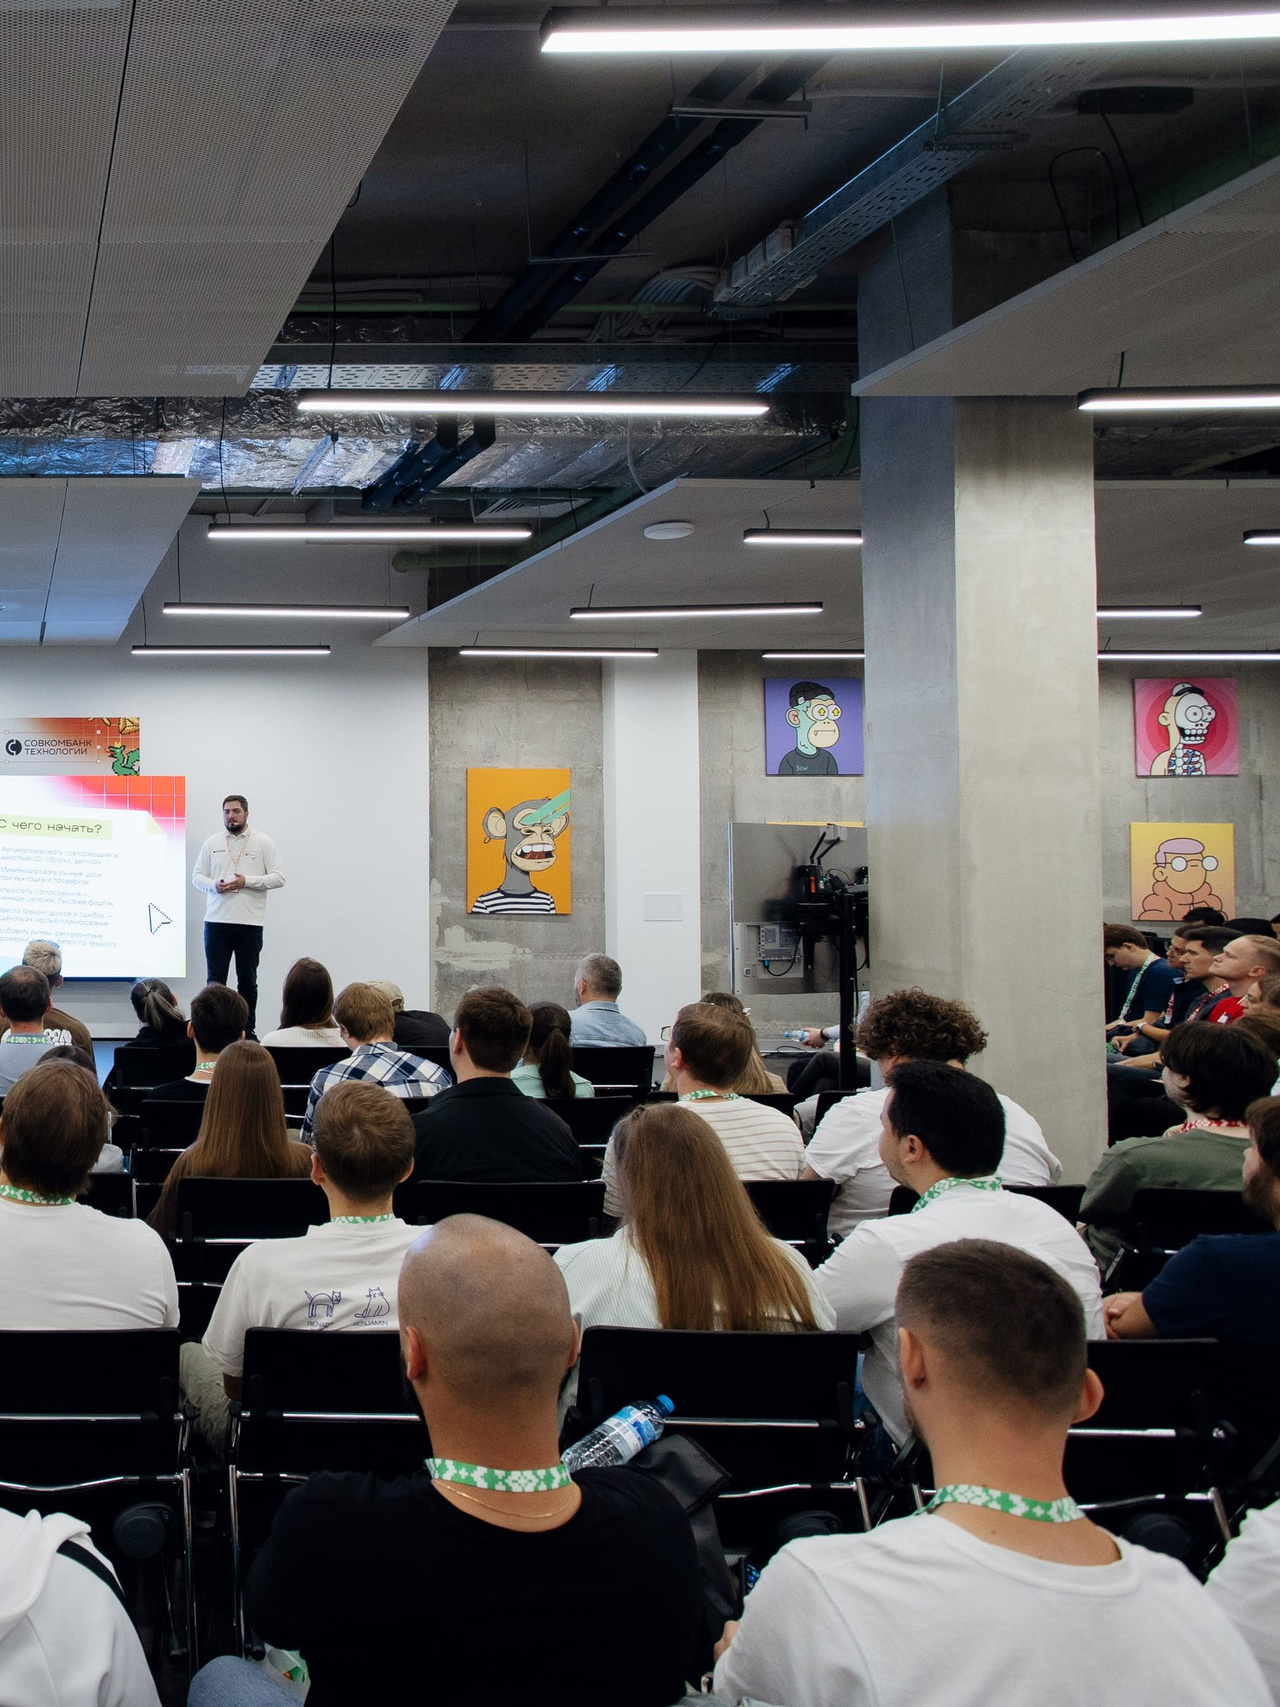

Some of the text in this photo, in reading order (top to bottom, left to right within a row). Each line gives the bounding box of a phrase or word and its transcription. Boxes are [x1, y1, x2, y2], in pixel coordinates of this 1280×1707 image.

[24, 739, 92, 747] СОВКОМБАНК
[25, 748, 88, 756] ТЕХНОЛОГИИ
[12, 822, 42, 832] чего
[48, 823, 102, 834] начать?
